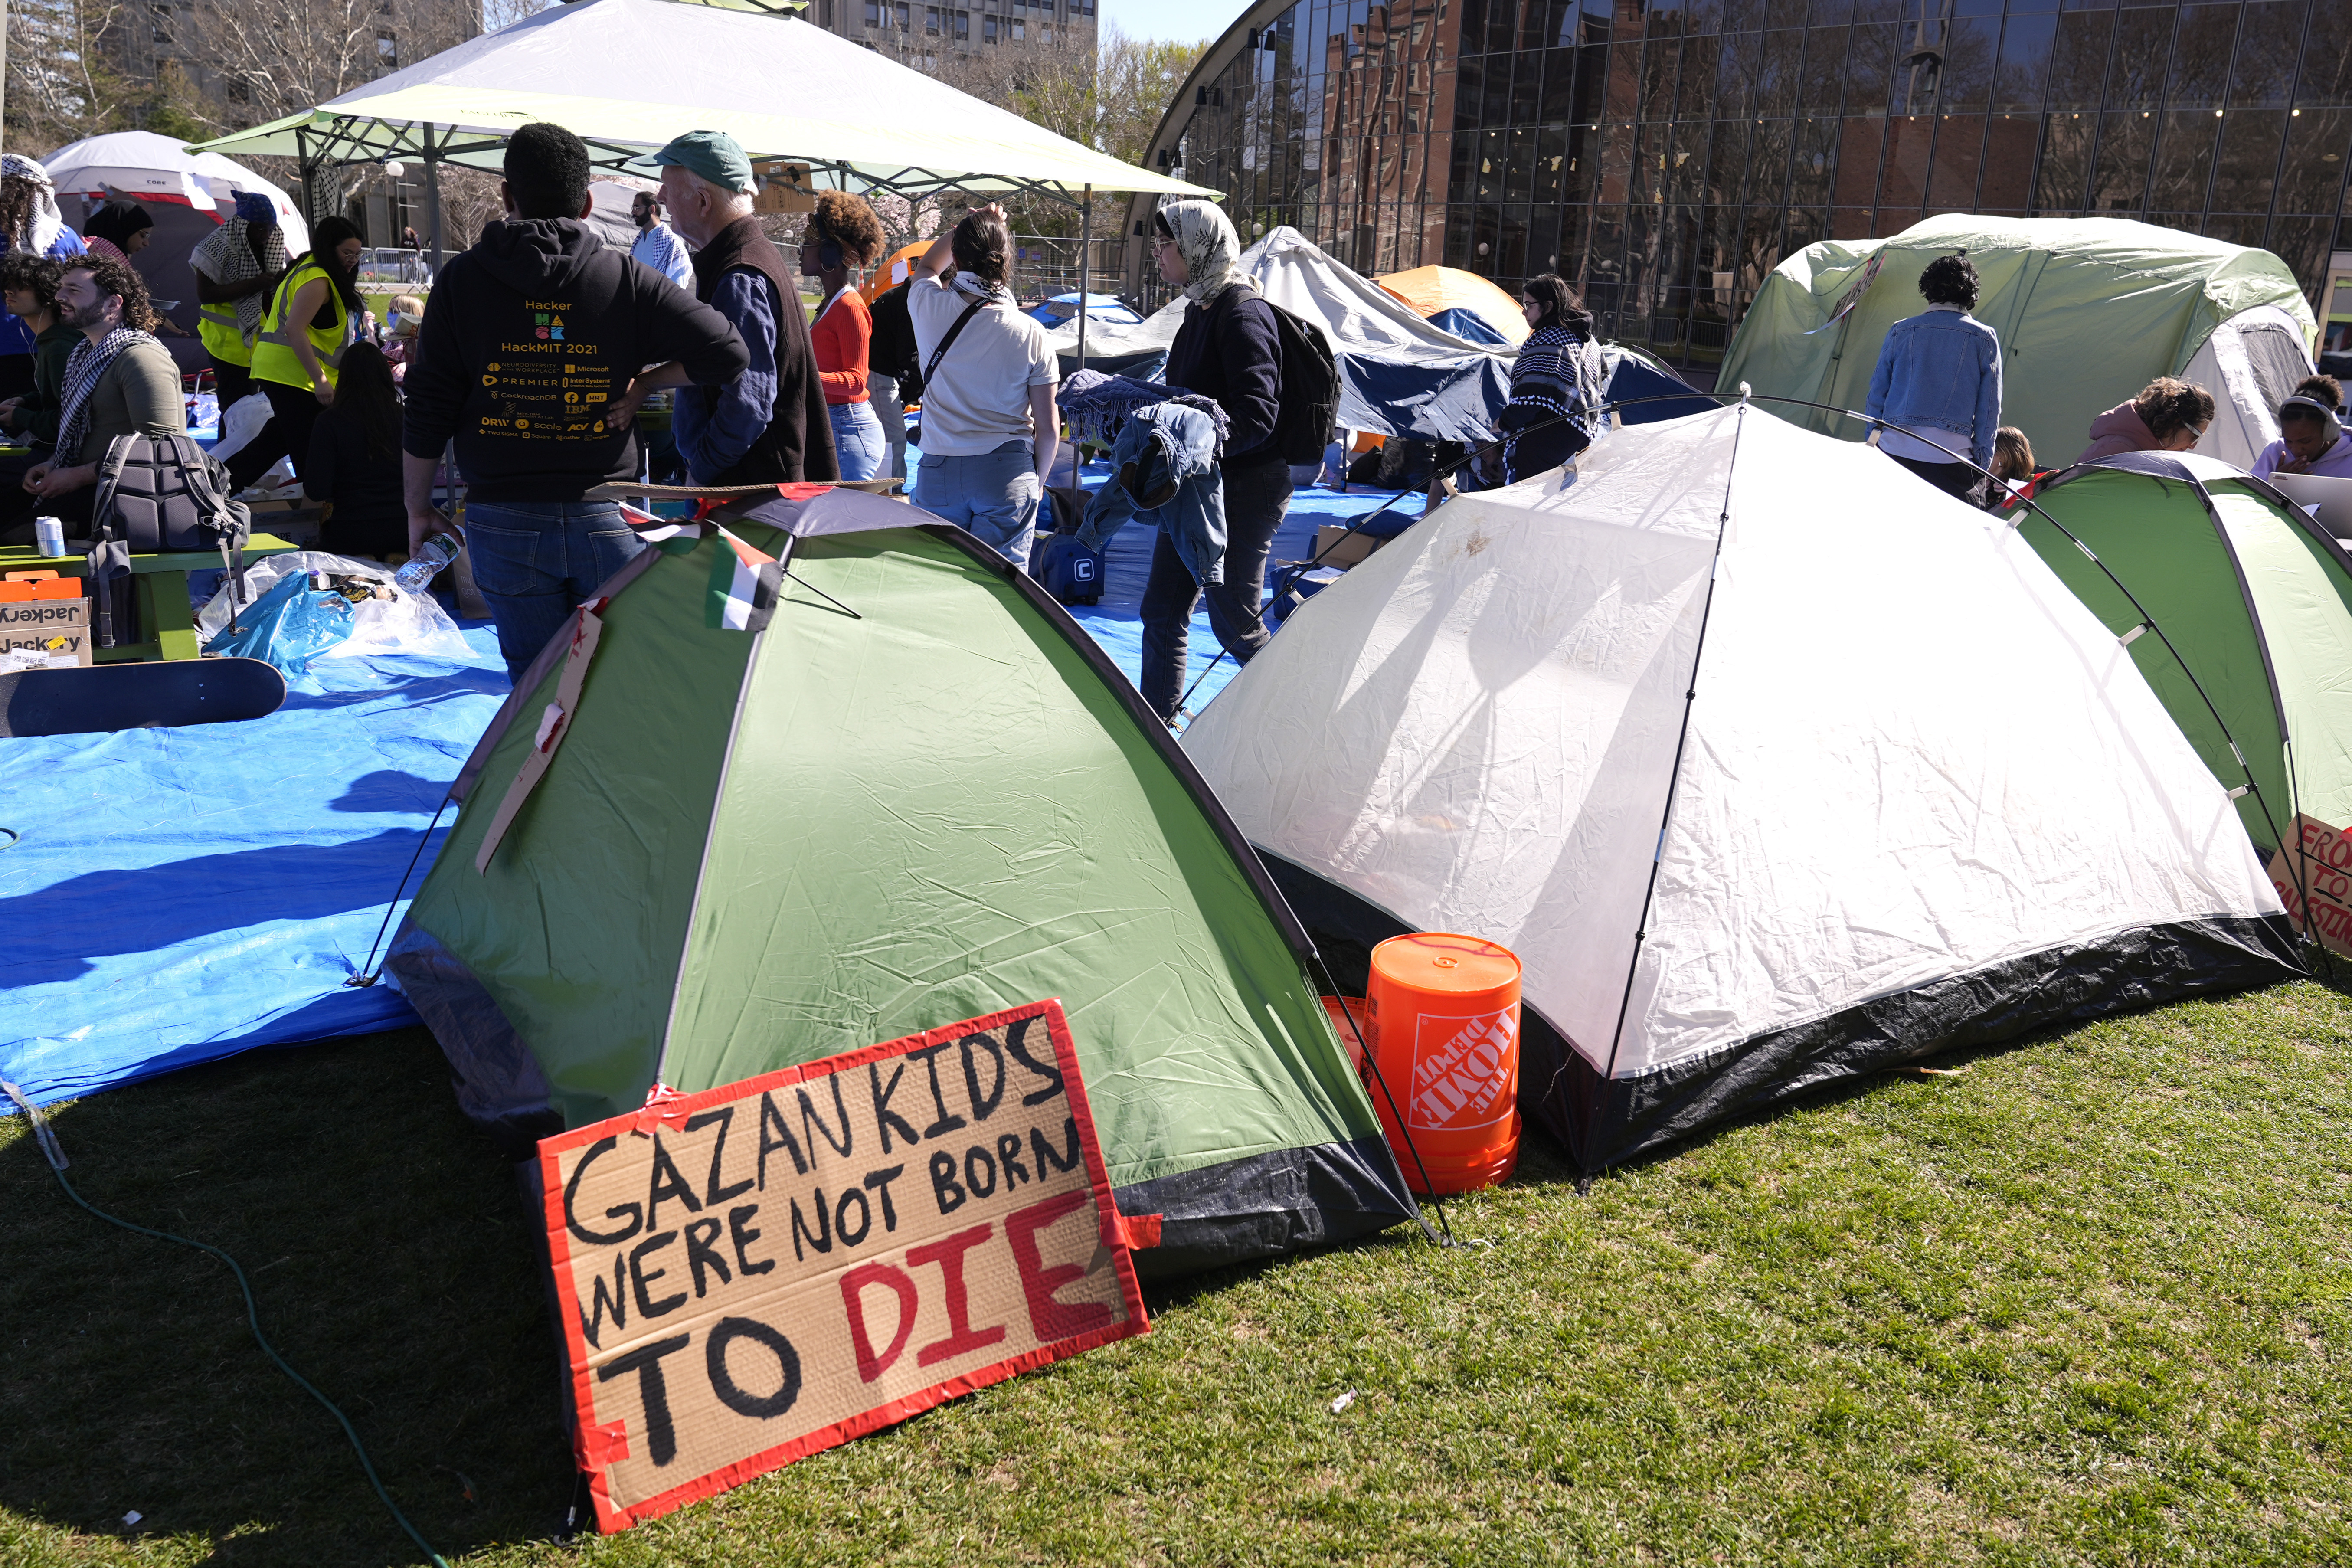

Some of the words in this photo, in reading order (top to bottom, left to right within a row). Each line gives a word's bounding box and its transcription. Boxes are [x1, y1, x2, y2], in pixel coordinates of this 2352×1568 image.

[526, 300, 572, 310] Hacker
[502, 343, 562, 353] HackMIT
[567, 344, 597, 354] 2021
[930, 351, 942, 367] Canon
[502, 378, 558, 386] PREMIER
[501, 393, 557, 401] CockroachDB
[565, 404, 590, 414] IBM
[481, 417, 510, 426] DRW
[567, 423, 589, 432] ACV
[2295, 824, 2352, 868] FRO
[2313, 864, 2349, 897] TO
[1415, 1018, 1487, 1087] DEPOT
[1412, 1011, 1515, 1128] HOME
[1469, 1066, 1509, 1115] THE
[563, 1073, 853, 1244] GAZAN
[870, 1013, 1064, 1154] KIDS
[579, 1204, 775, 1349] WERE
[790, 1165, 904, 1260] NOT
[929, 1117, 1080, 1214] BORN
[598, 1316, 801, 1467] TO
[839, 1187, 1116, 1383] DIE
